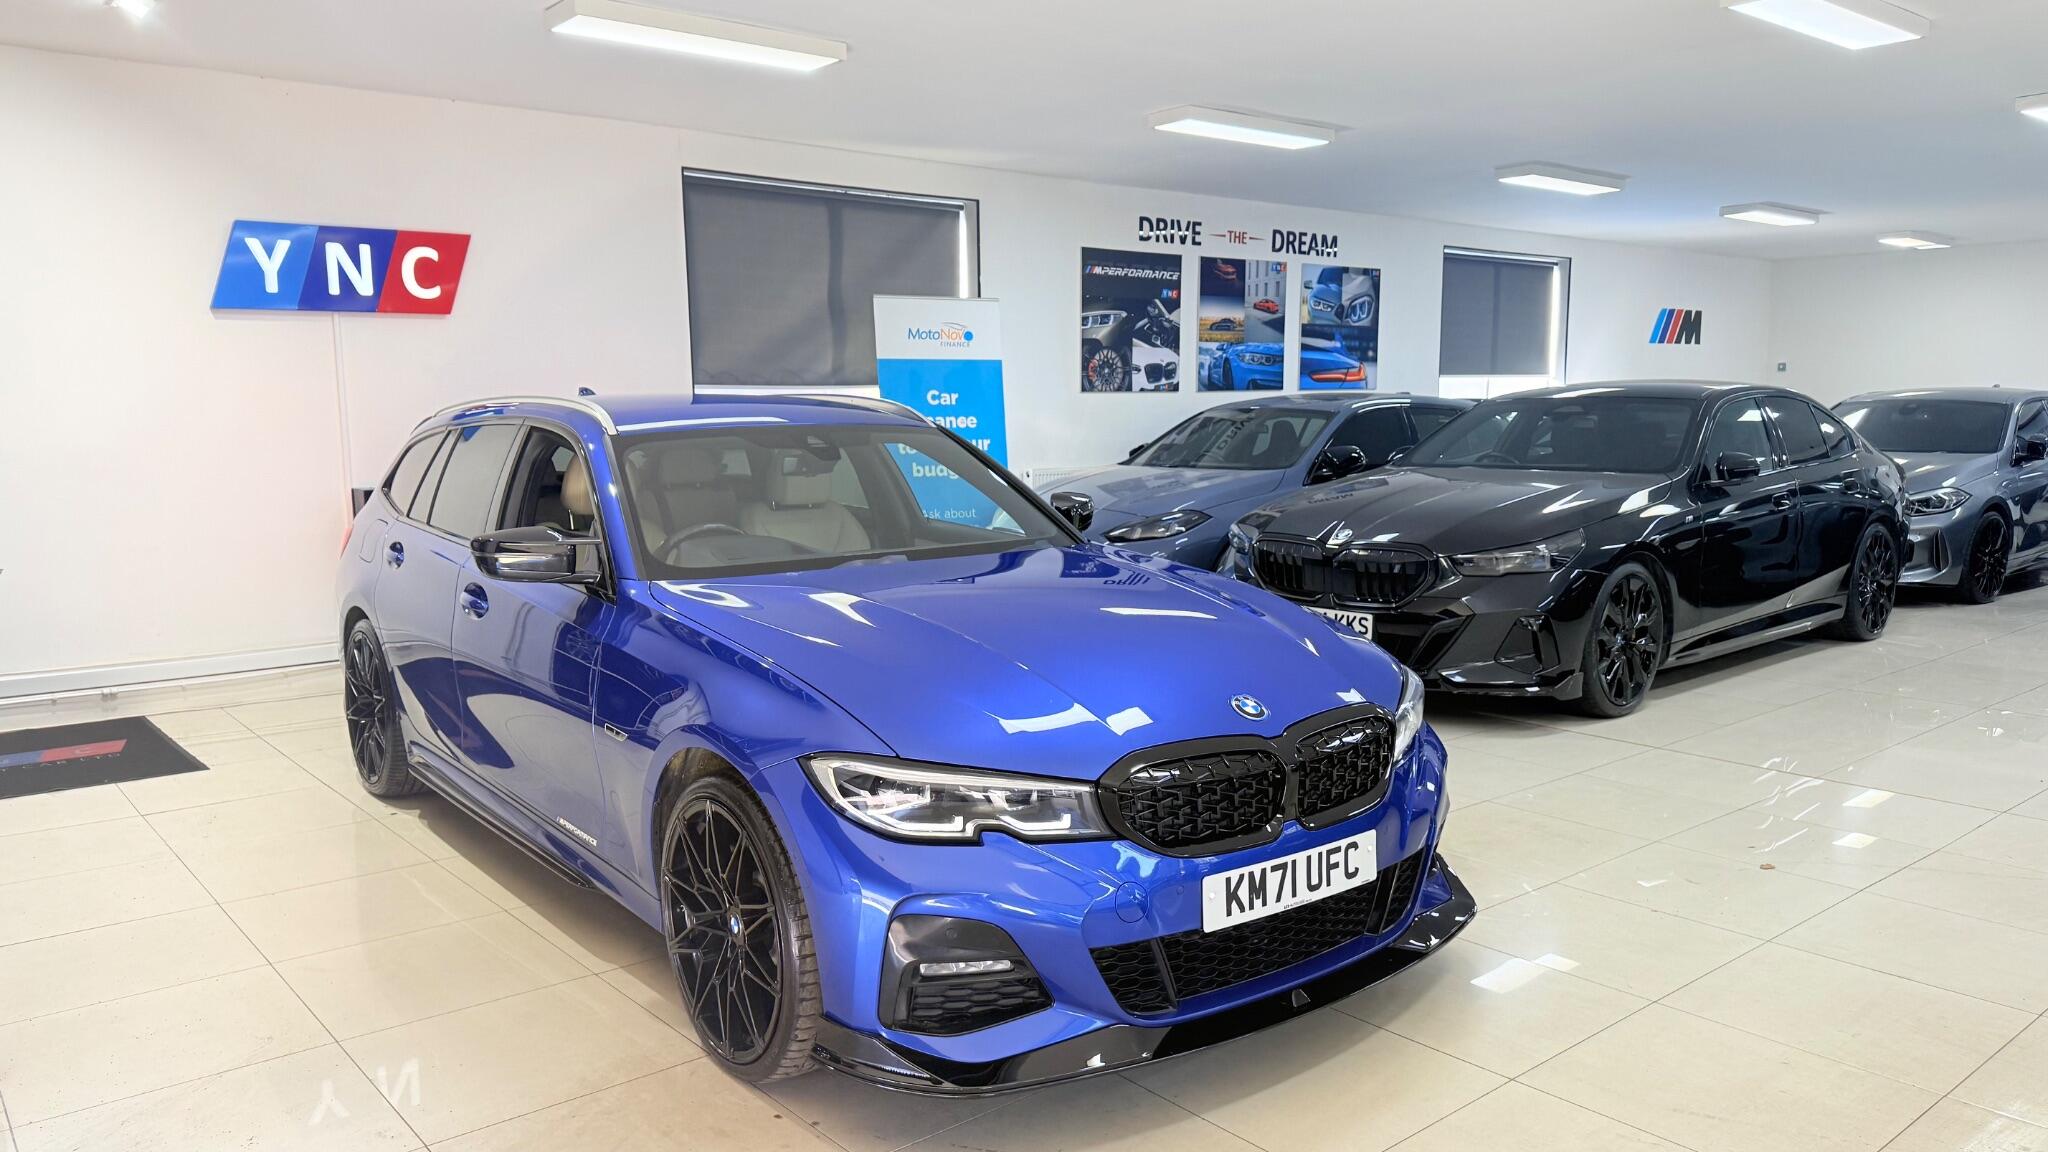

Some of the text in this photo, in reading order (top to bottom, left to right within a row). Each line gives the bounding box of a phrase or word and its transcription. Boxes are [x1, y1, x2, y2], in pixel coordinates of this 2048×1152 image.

[1138, 216, 1338, 258] DRIVE THE DREAM
[244, 237, 441, 299] YNC
[927, 390, 958, 405] Car
[927, 415, 977, 428] ance
[944, 508, 976, 518] about
[1225, 841, 1360, 917] KM71 UFC
